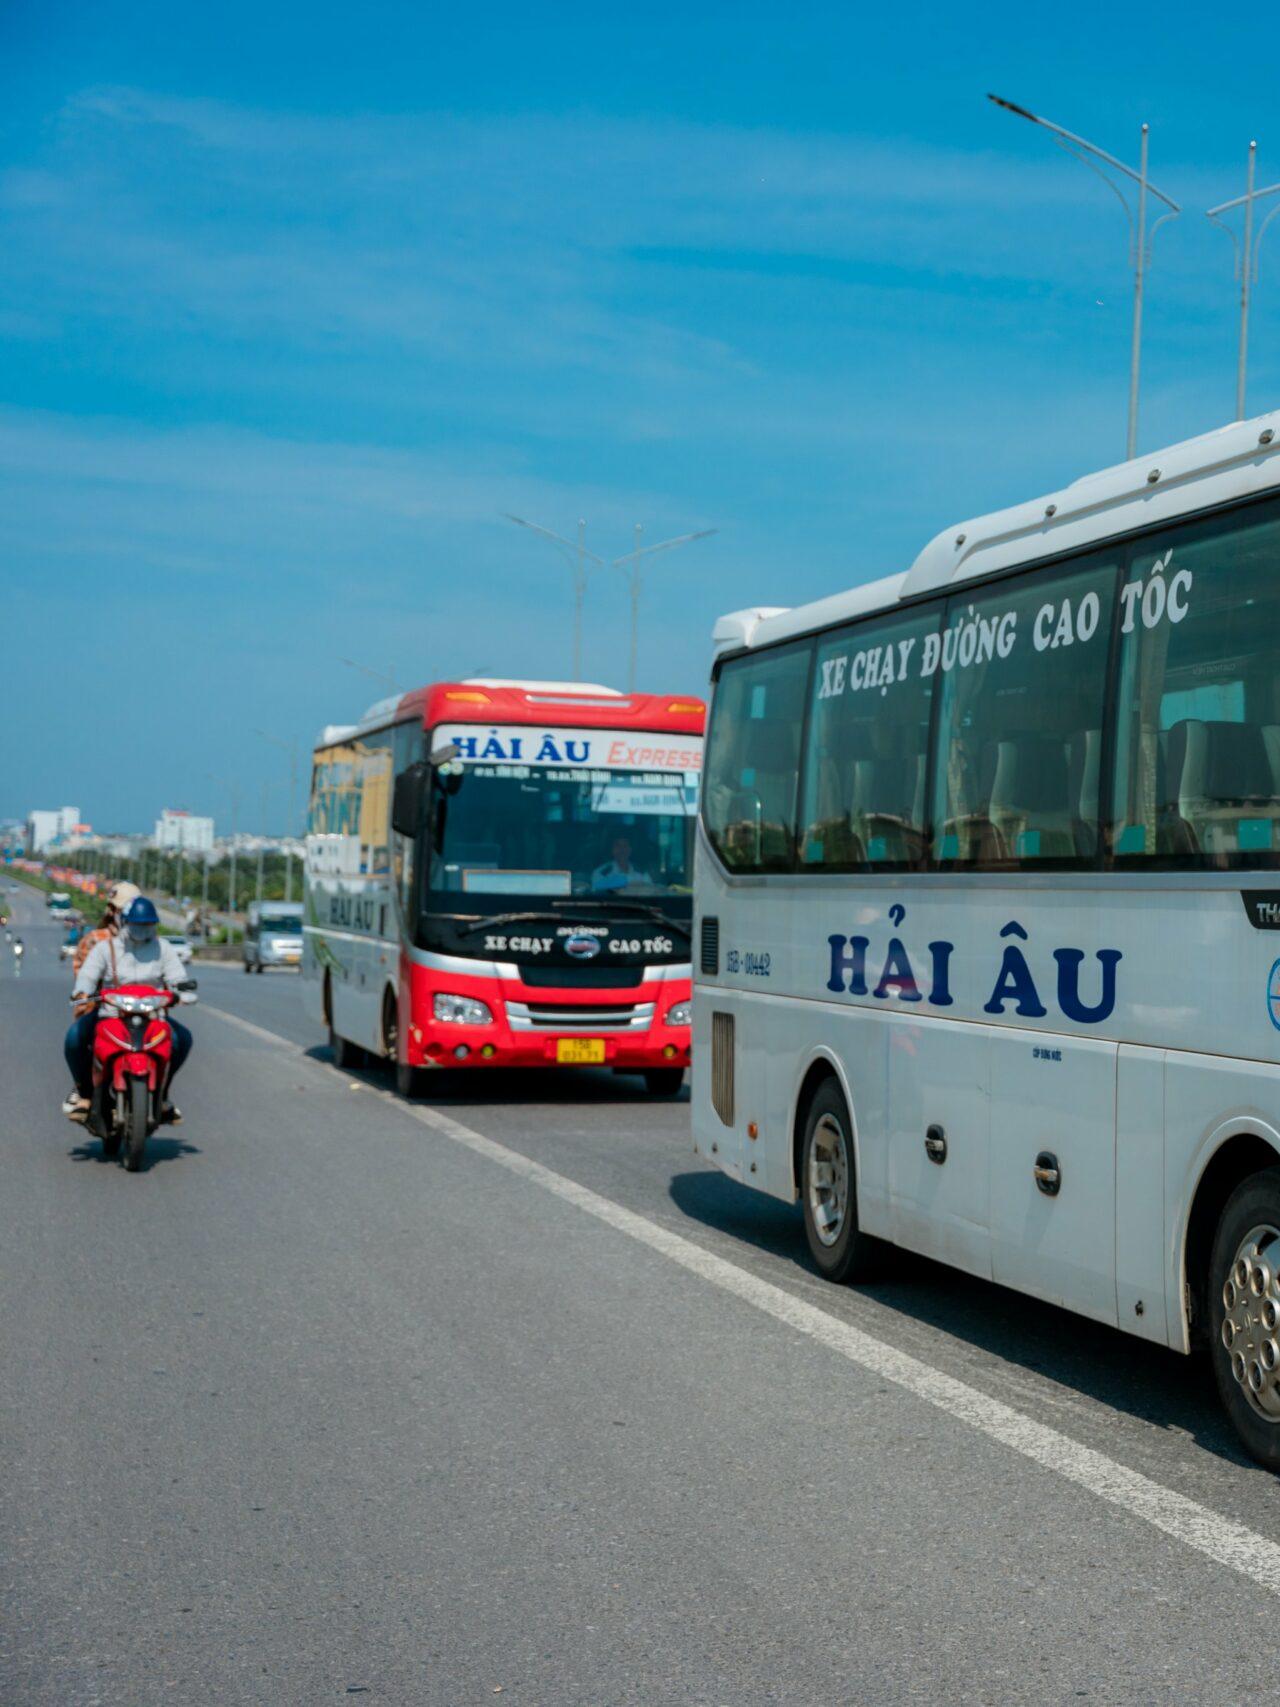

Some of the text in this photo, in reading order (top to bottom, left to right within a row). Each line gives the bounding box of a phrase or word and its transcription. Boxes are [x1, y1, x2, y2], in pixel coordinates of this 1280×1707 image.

[818, 549, 1192, 699] XE CHẠY ĐƯỜNG CAO TỐC
[452, 729, 522, 760] HẢI
[535, 734, 590, 763] ÂU
[484, 936, 507, 950] XE
[509, 937, 553, 954] CHẠY
[609, 940, 640, 953] CAO
[827, 904, 1122, 1024] HẢI ÂU
